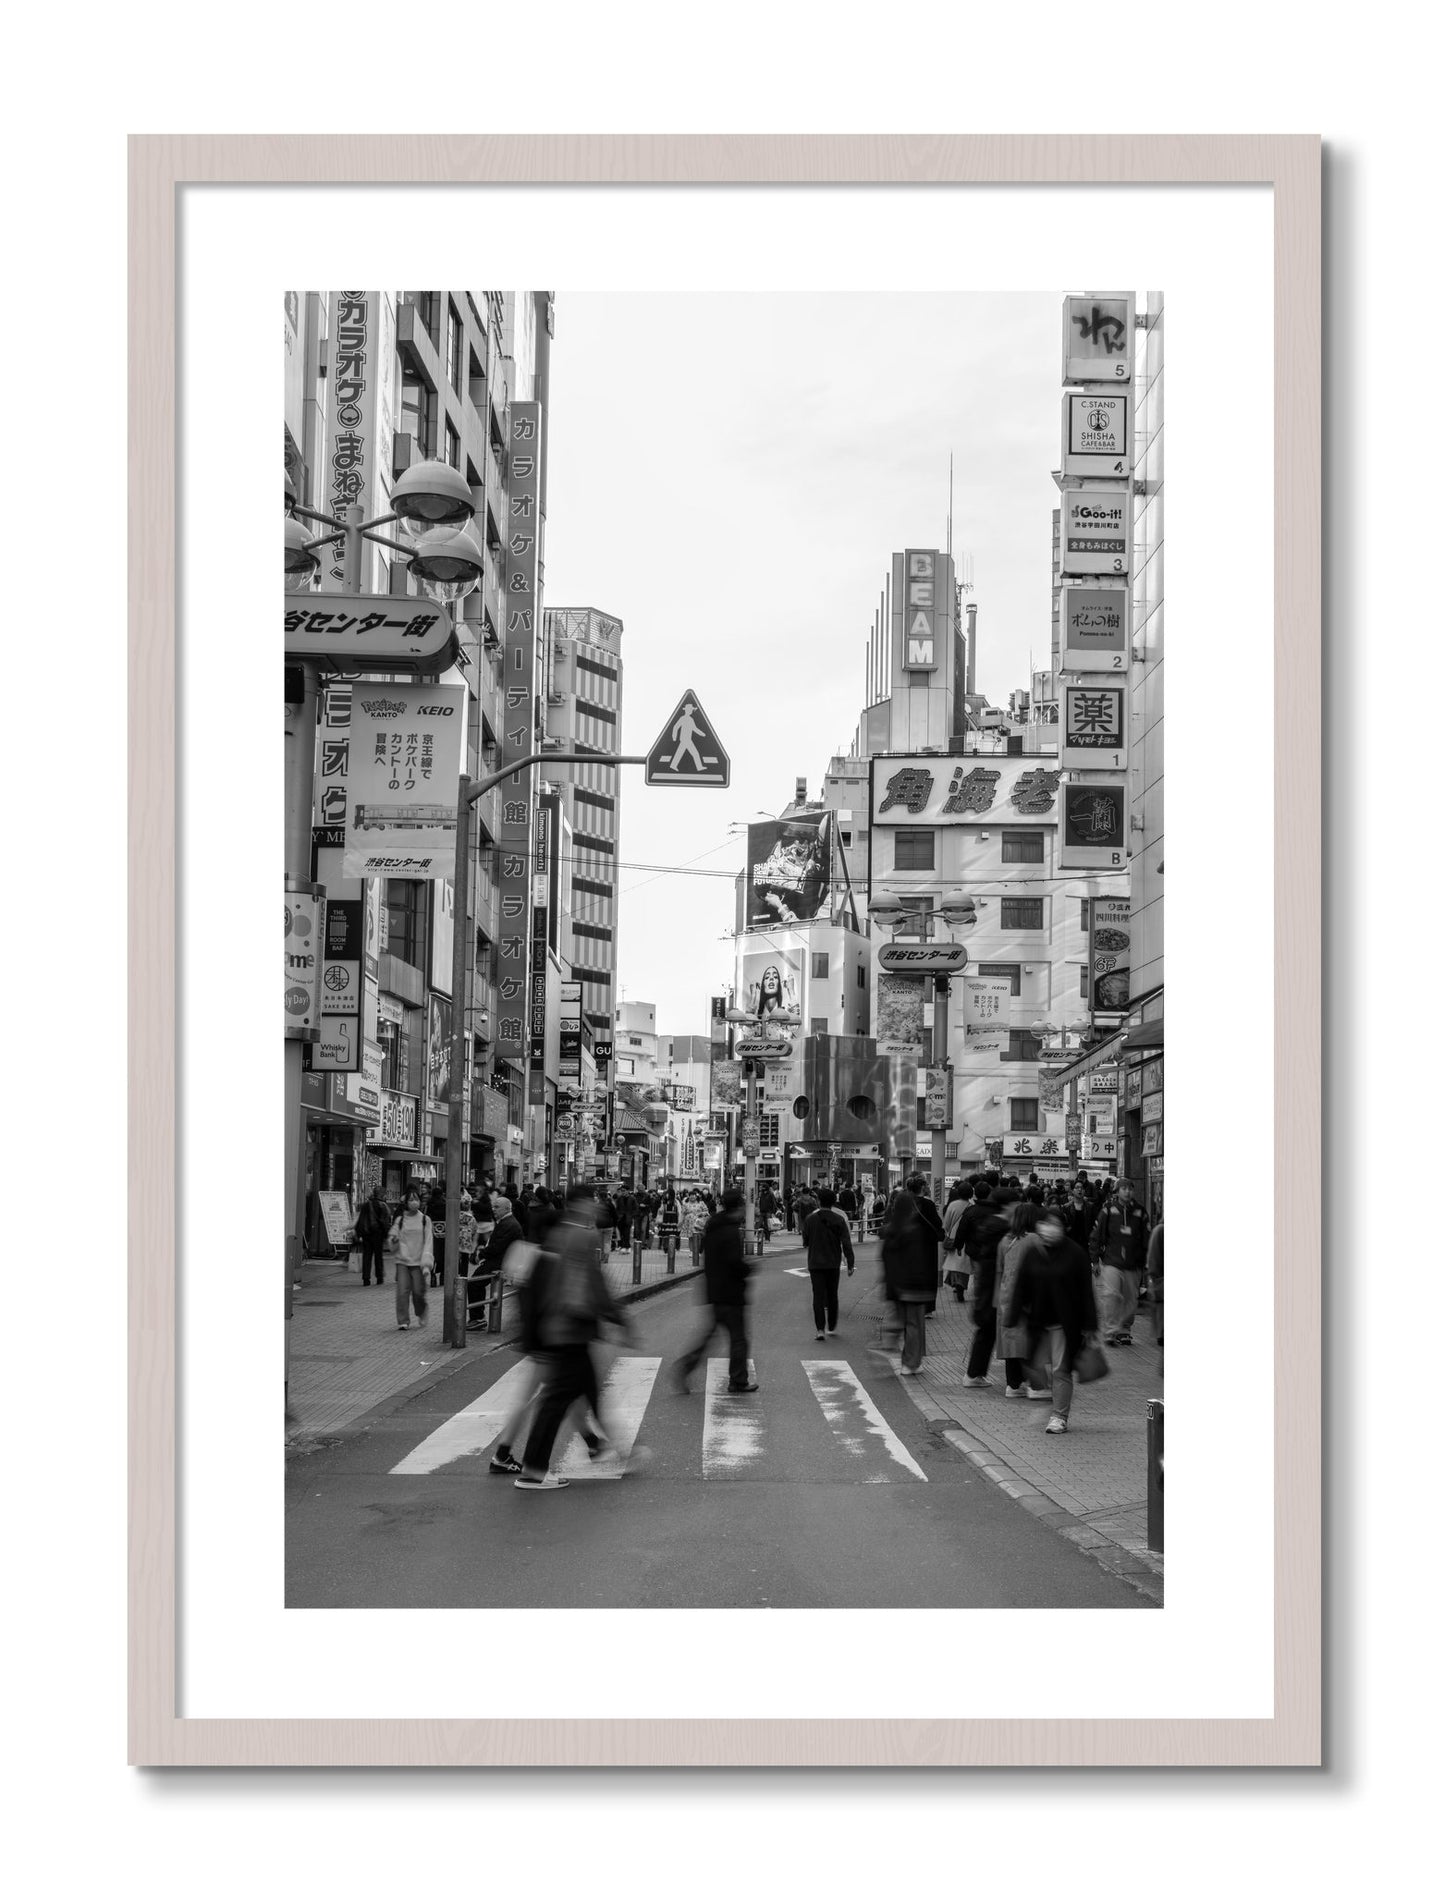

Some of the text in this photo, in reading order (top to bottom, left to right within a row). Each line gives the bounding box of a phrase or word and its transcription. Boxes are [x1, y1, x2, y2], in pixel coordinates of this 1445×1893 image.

[335, 300, 368, 405] カラオケ
[1115, 364, 1125, 377] 5
[1080, 401, 1116, 409] C.STAND
[1081, 432, 1115, 441] SHISHA
[1080, 507, 1122, 519] Goo-it!
[1071, 541, 1123, 550] 全身もみほぐし
[1113, 559, 1123, 571] 3
[911, 552, 937, 665] BEAM
[1113, 657, 1122, 668] 2
[417, 706, 454, 717] KEIO
[1074, 694, 1112, 732] 薬
[374, 733, 387, 766] 冒険へ
[389, 734, 402, 790] カントーの
[421, 734, 434, 780] 京王線で
[1113, 755, 1119, 766] 1
[879, 766, 1061, 814] 角海老
[538, 812, 547, 840] kimono
[365, 857, 433, 868] 渋谷センター街
[1112, 853, 1120, 864] B
[885, 950, 962, 965] 渋谷センター街
[1094, 957, 1117, 972] 6F
[319, 1051, 336, 1059] Bank
[320, 1044, 347, 1056] Whisky
[595, 1046, 612, 1055] GU
